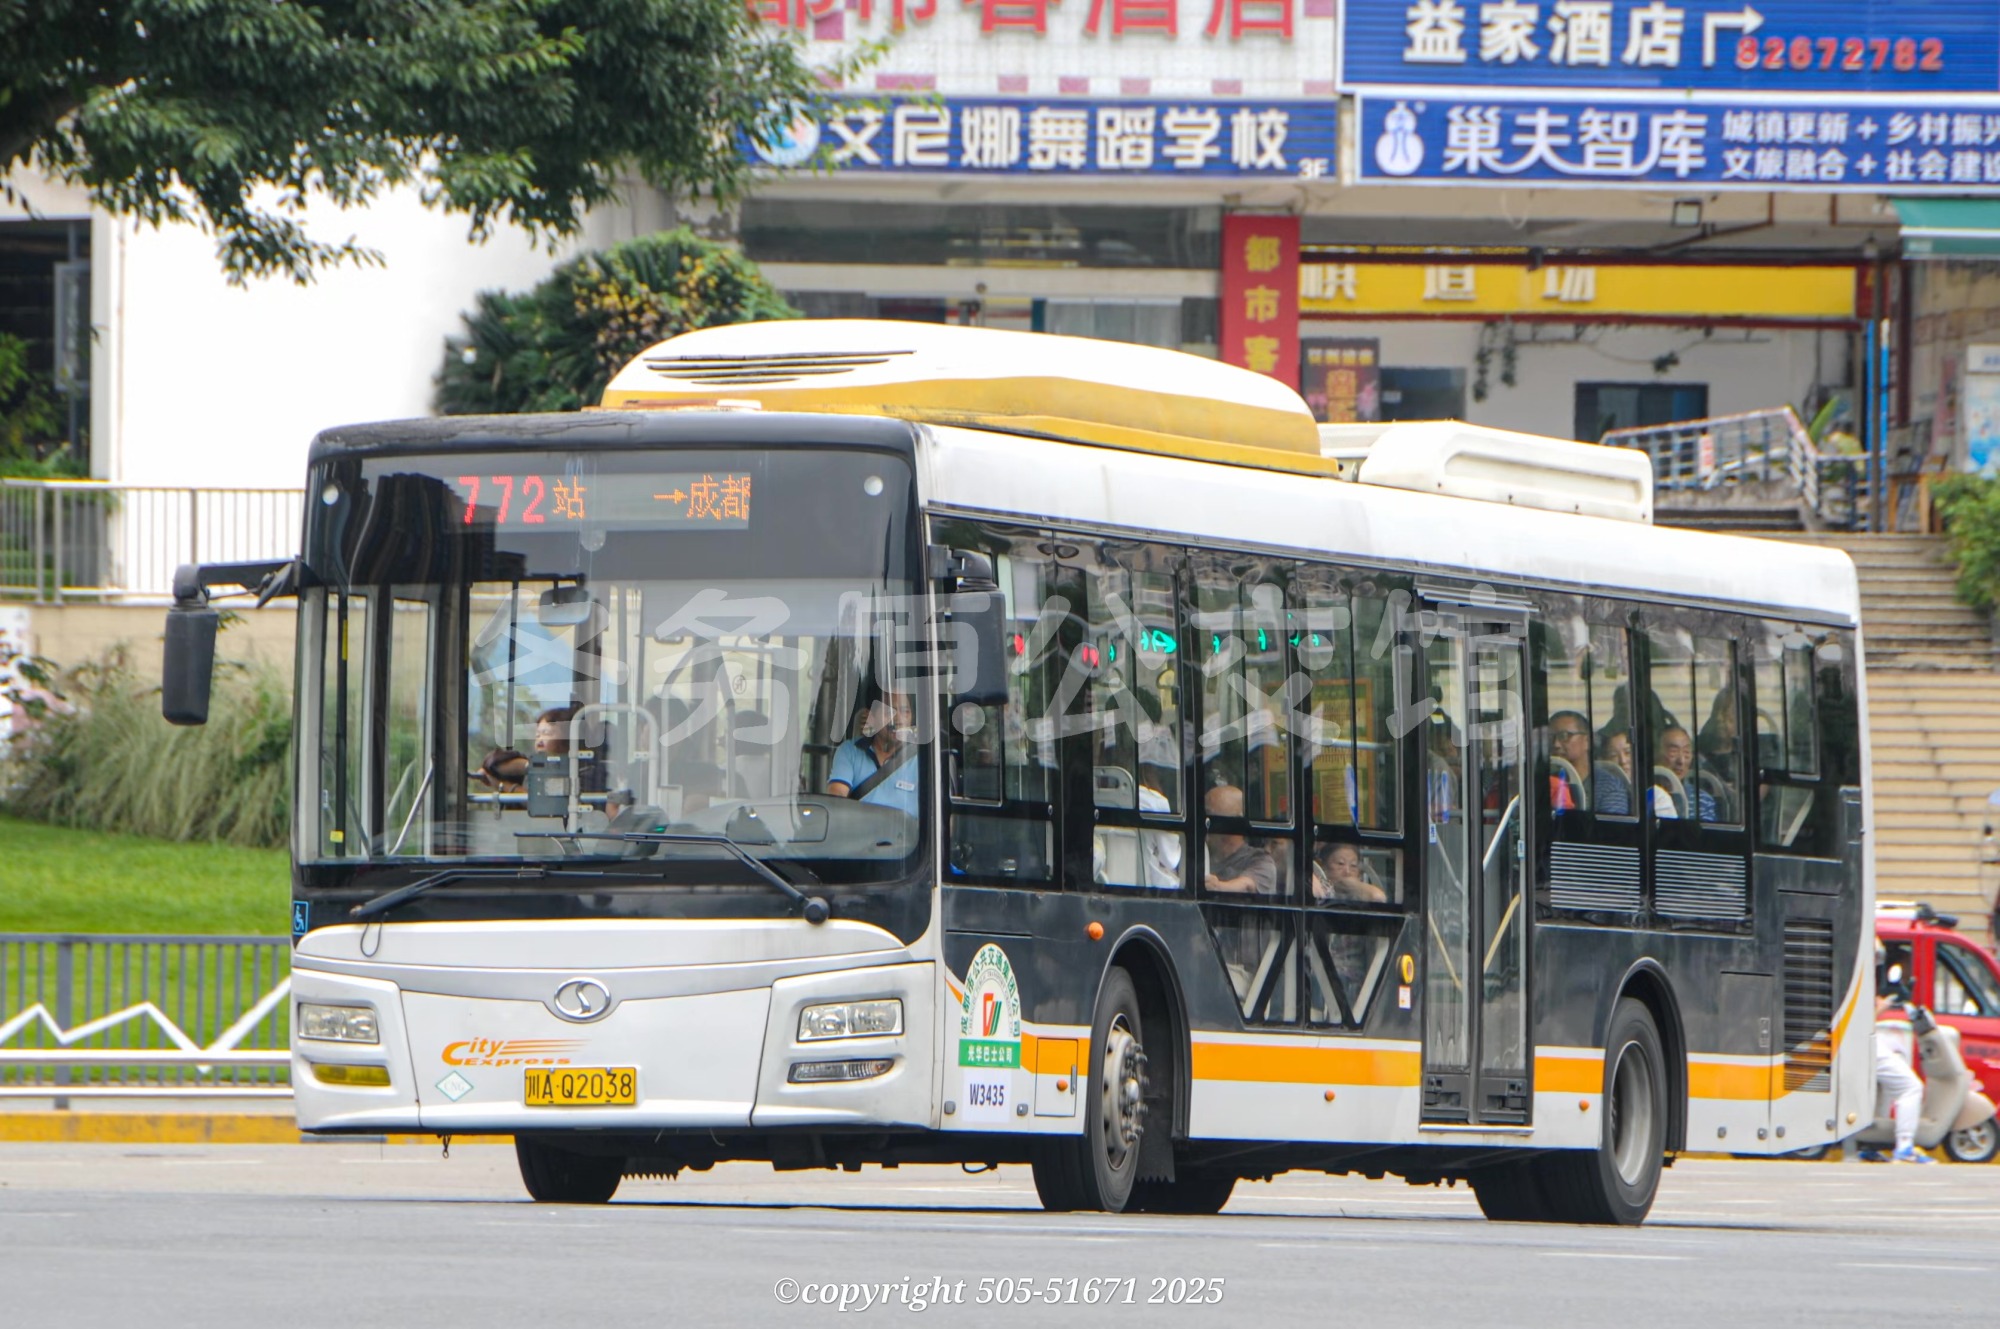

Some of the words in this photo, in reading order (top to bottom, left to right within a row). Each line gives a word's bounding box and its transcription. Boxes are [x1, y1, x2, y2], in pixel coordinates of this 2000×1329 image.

[1403, 1, 1686, 67] 益家酒店
[1735, 36, 1944, 71] 82672782
[826, 102, 1290, 170] 艾尼娜舞蹈学校
[1441, 104, 1708, 178] 巢夫智库
[1299, 157, 1329, 179] 3F
[1243, 235, 1281, 372] 都市客
[458, 475, 546, 526] 772
[552, 475, 588, 519] 站
[687, 474, 751, 521] 成都
[441, 1037, 503, 1066] City
[462, 1057, 571, 1067] Express
[968, 1044, 1013, 1064] 光华巴士公司
[969, 1083, 1005, 1106] W3435
